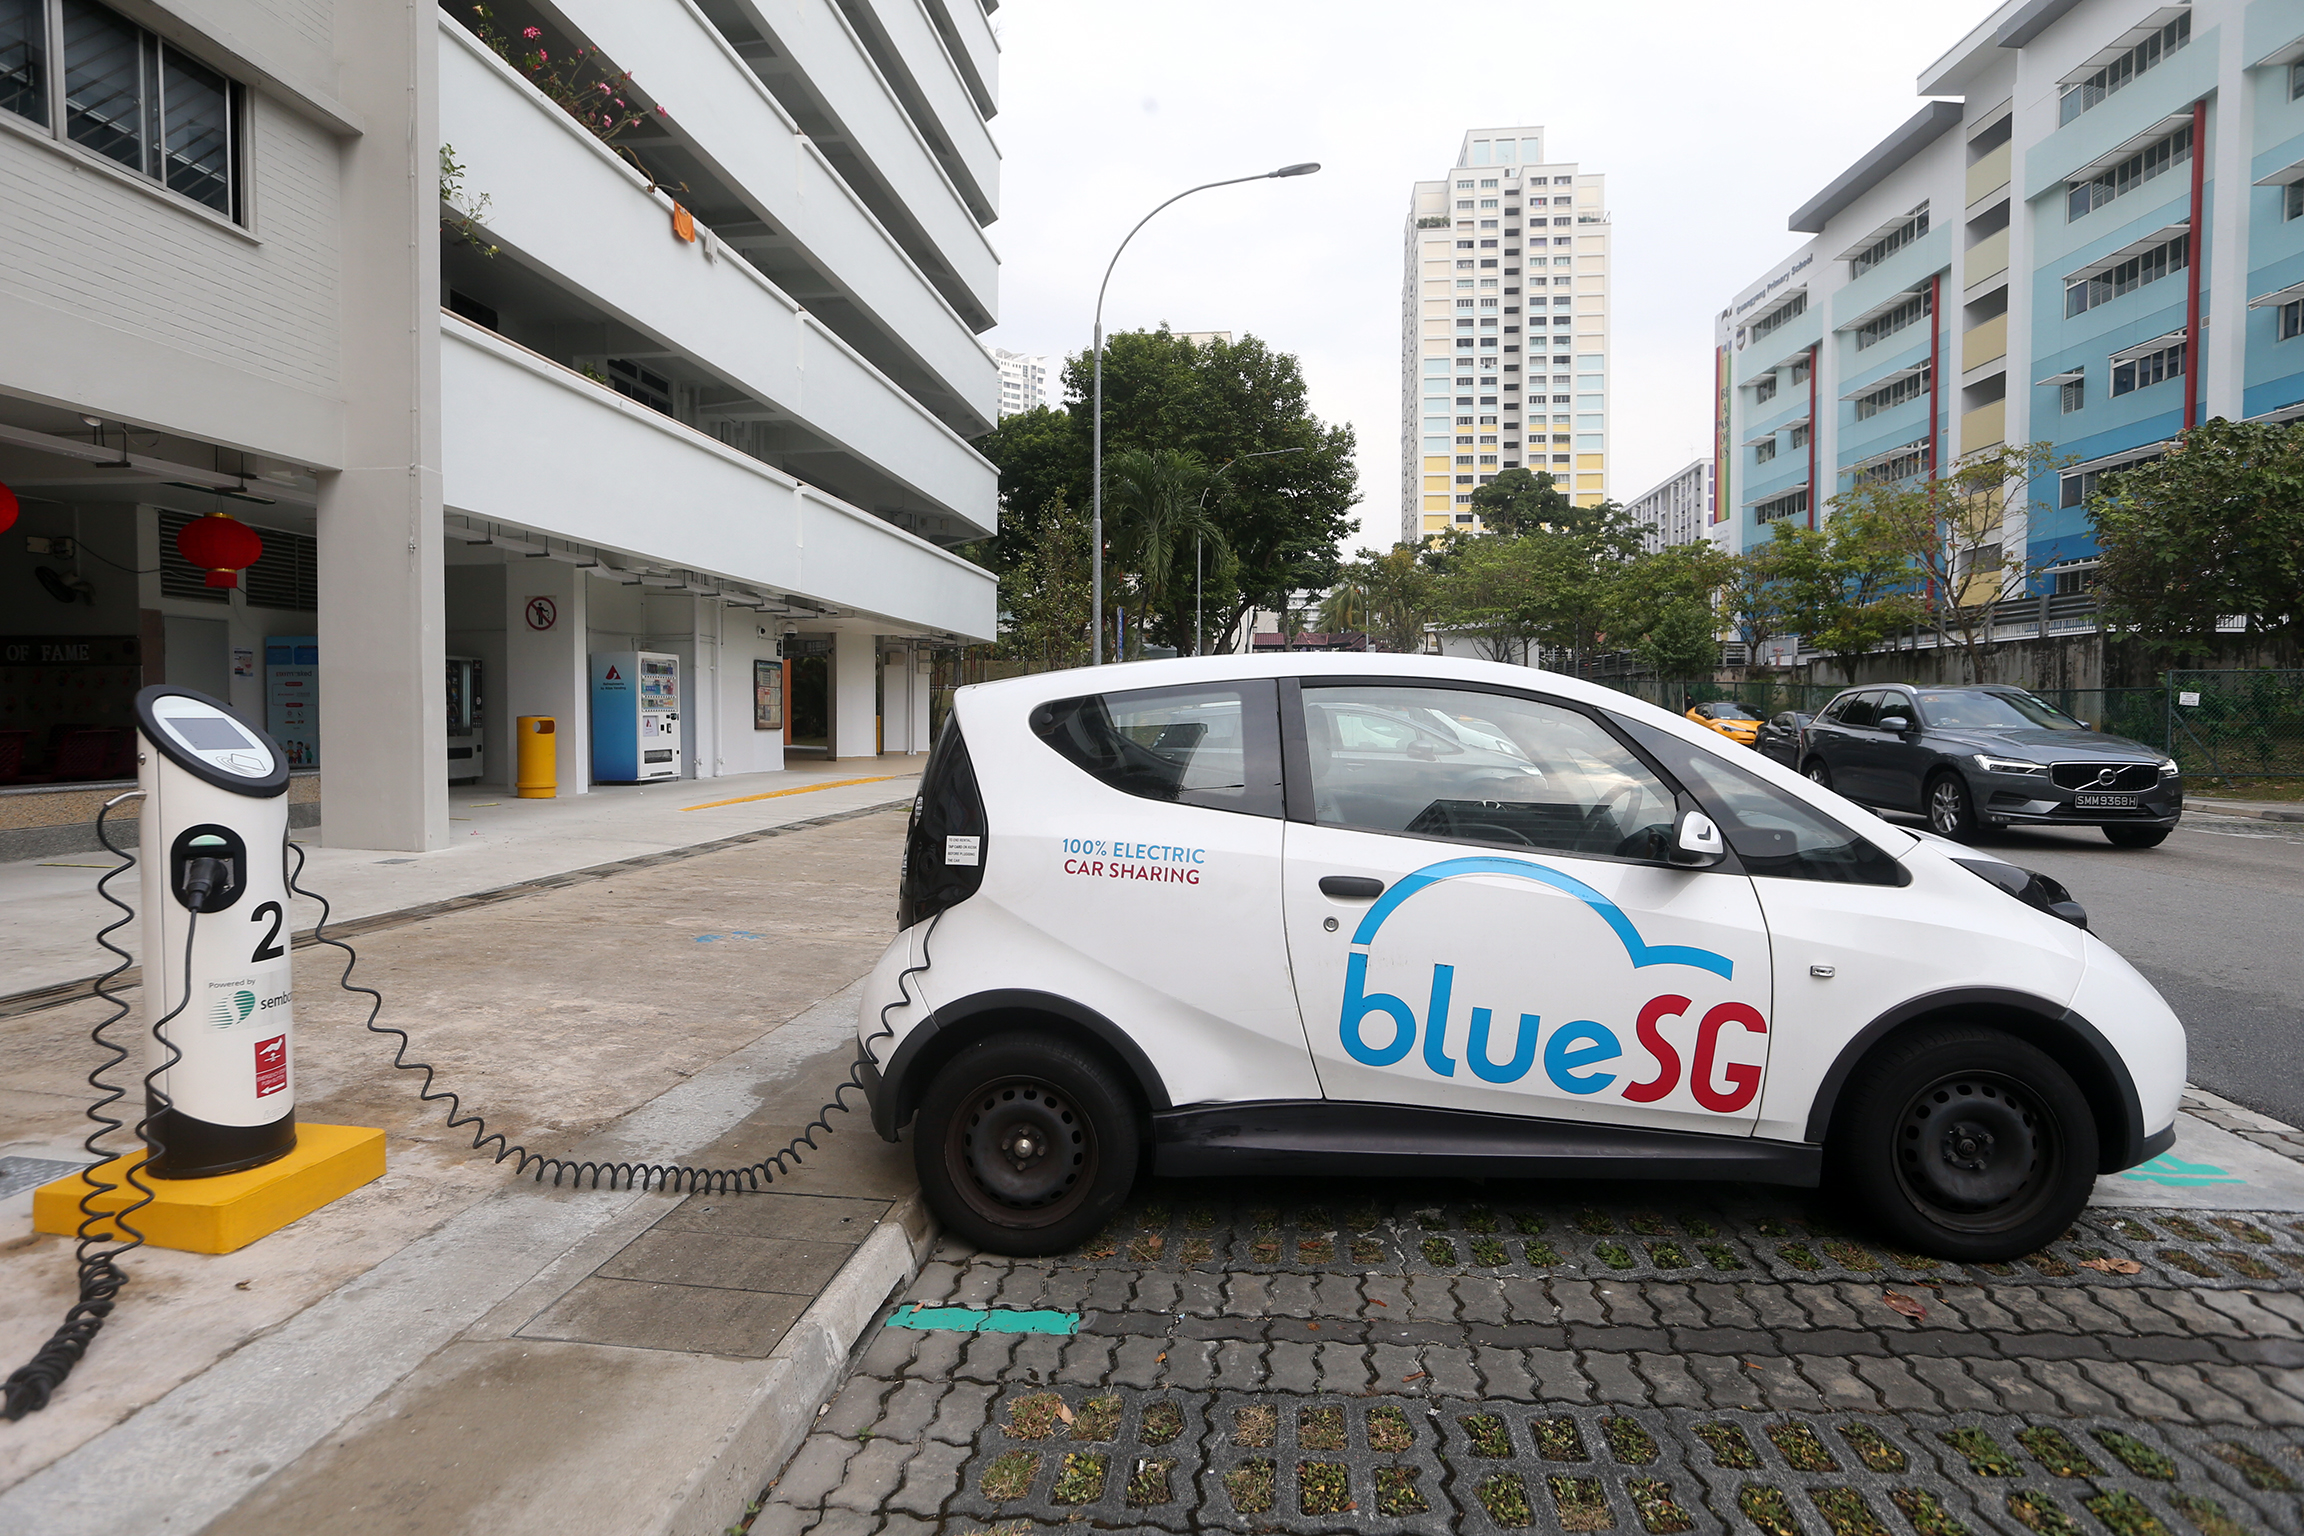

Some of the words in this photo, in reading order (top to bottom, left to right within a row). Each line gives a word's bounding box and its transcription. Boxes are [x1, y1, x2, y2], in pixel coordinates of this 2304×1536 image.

[1736, 289, 1766, 315] Guangyang
[1767, 271, 1790, 293] Primary
[1791, 253, 1813, 275] School
[1720, 385, 1730, 400] BE
[1720, 430, 1730, 445] OF
[1720, 445, 1729, 460] US
[6, 644, 30, 661] OF
[40, 644, 90, 661] FAME
[2077, 795, 2136, 806] SMM9368H
[1062, 838, 1107, 856] 100%
[1113, 842, 1206, 864] ELECTRIC
[1064, 859, 1104, 876] CAR
[1109, 863, 1200, 885] SHARING
[251, 901, 284, 963] 2
[208, 979, 245, 988] Powered
[247, 978, 256, 986] by
[1338, 952, 1767, 1114] blueSG
